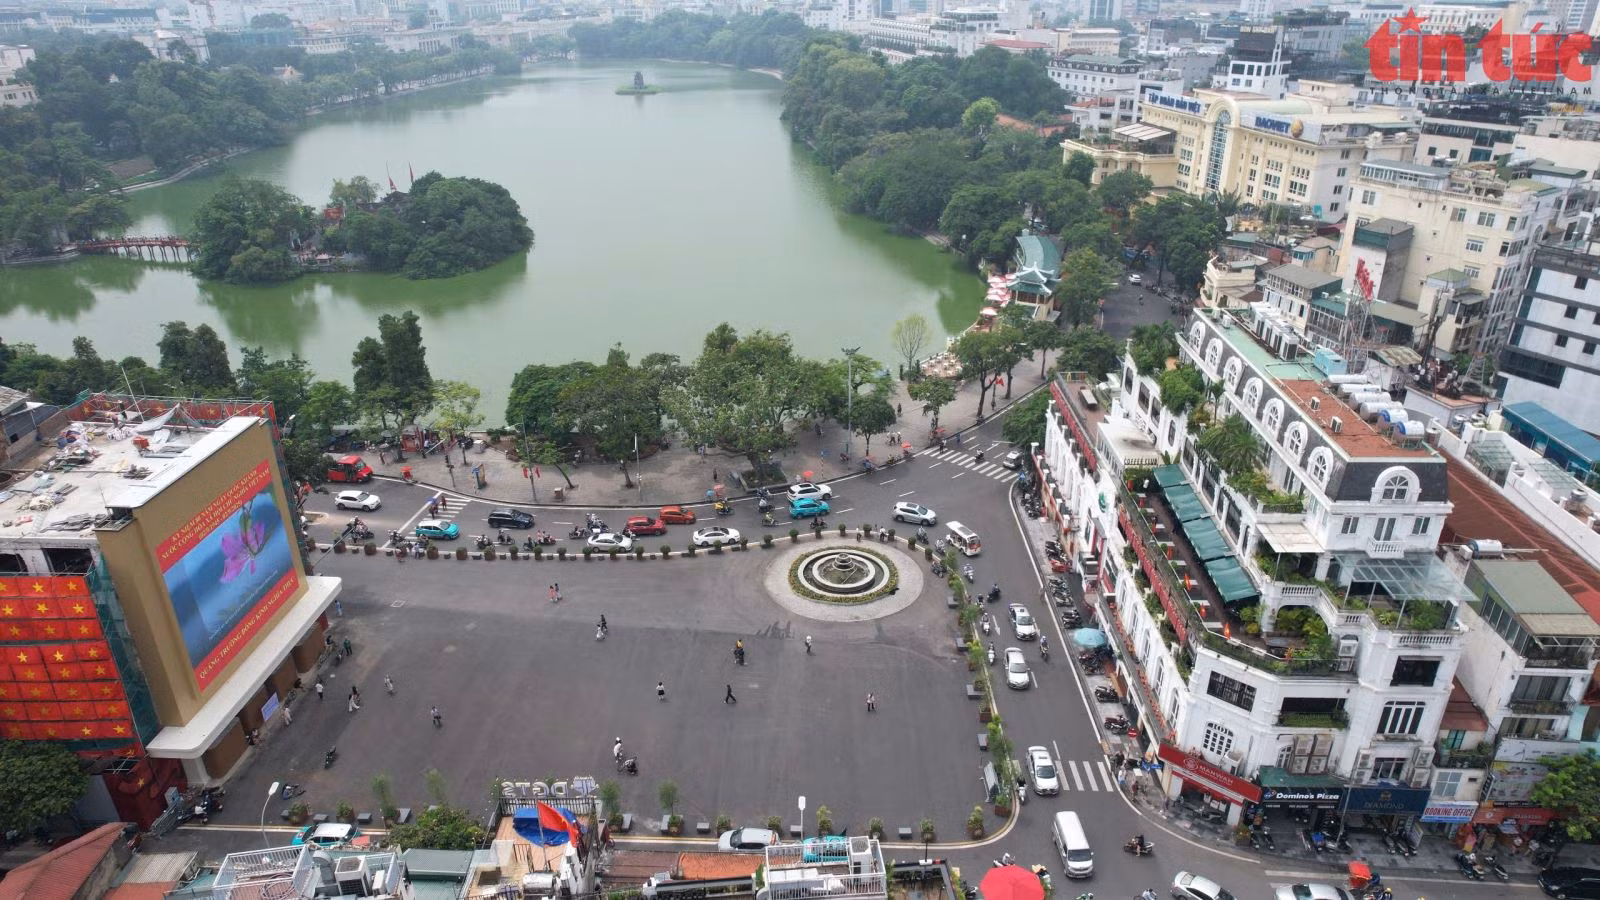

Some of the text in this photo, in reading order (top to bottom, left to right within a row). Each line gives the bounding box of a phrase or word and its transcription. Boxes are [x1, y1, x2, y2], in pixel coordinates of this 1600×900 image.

[1200, 766, 1233, 784] MANWAH
[1424, 808, 1474, 816] BOOKING OFFICE
